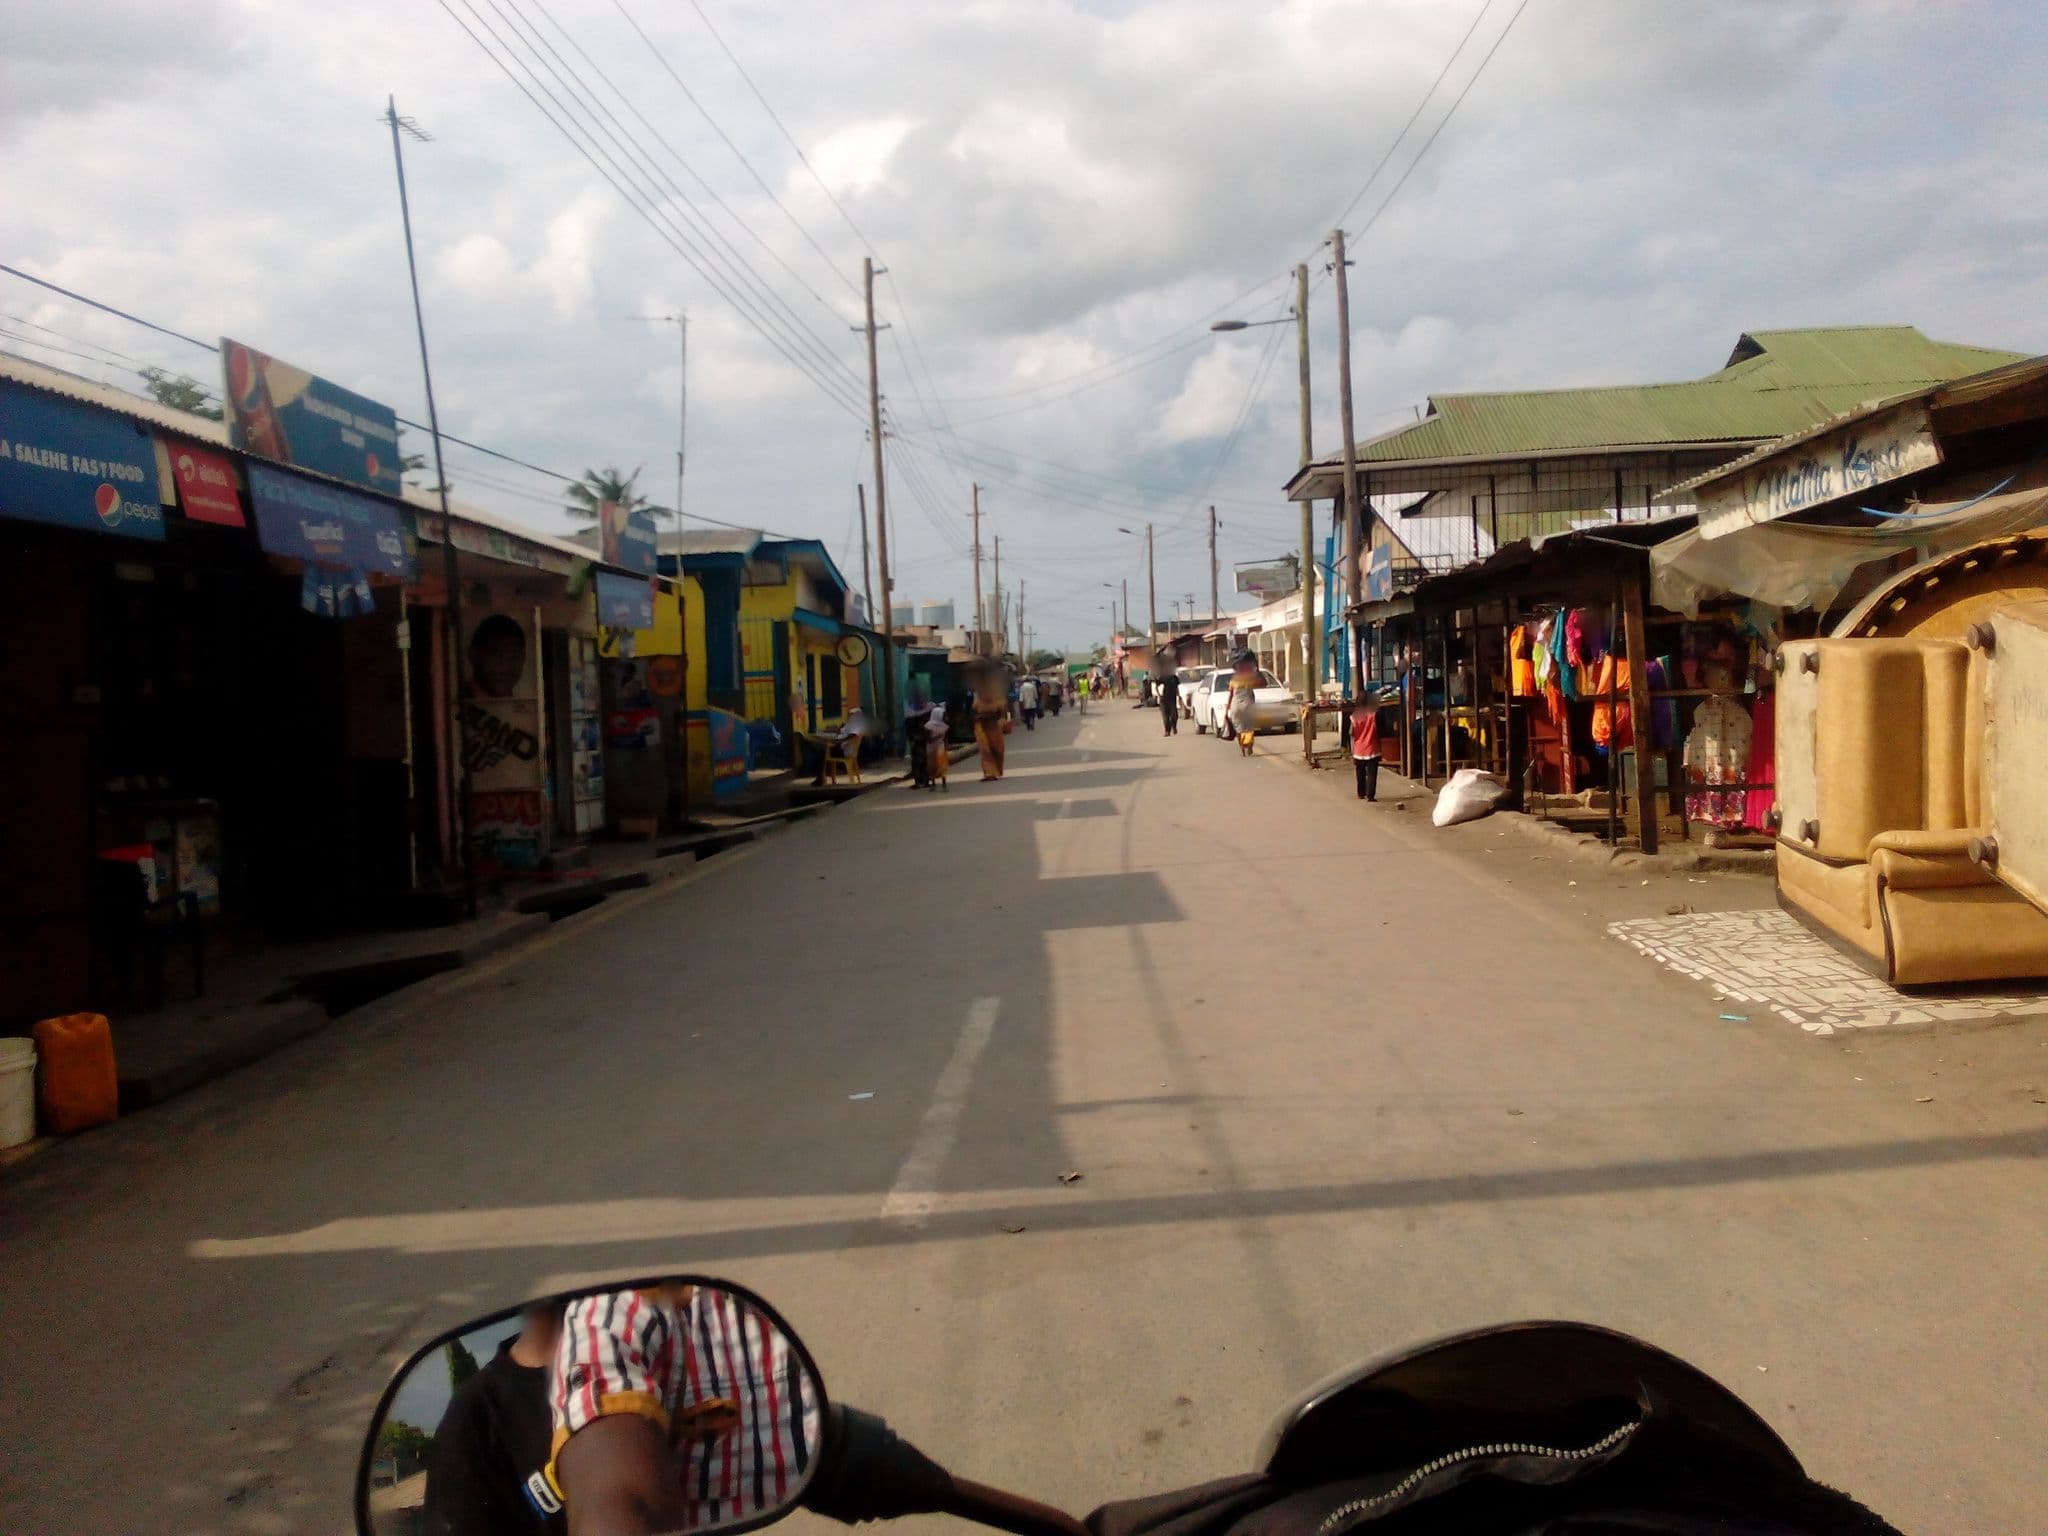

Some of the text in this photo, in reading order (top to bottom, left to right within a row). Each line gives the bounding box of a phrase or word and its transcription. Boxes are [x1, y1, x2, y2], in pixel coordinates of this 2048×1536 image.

[15, 442, 69, 471] SALEHE
[72, 455, 107, 478] FAST
[108, 461, 145, 483] FOOD
